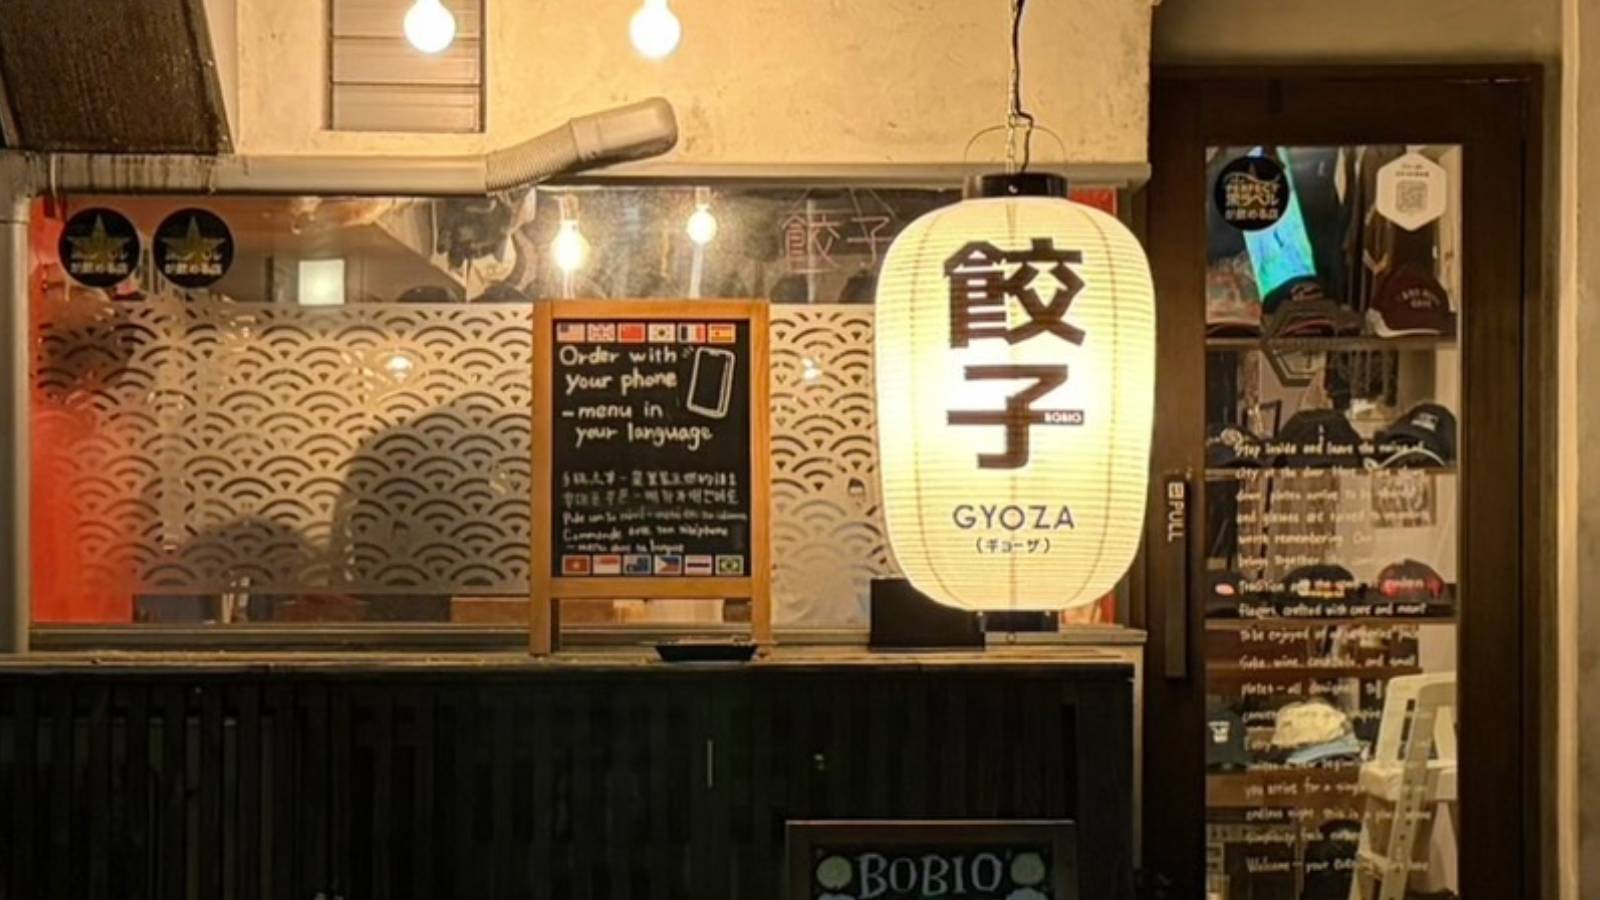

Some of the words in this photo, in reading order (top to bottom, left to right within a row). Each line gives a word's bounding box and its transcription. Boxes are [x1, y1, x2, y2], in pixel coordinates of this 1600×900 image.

[559, 345, 620, 366] Order
[629, 346, 678, 363] with
[943, 238, 1086, 469] 餃子
[564, 372, 613, 396] your
[620, 367, 678, 397] phone
[644, 401, 663, 419] in
[1044, 412, 1082, 423] BOBIO
[575, 426, 618, 449] your
[627, 421, 713, 451] language
[952, 504, 1075, 531] GYOZA
[1168, 501, 1185, 542] PULL
[857, 852, 1003, 899] BOBIO
